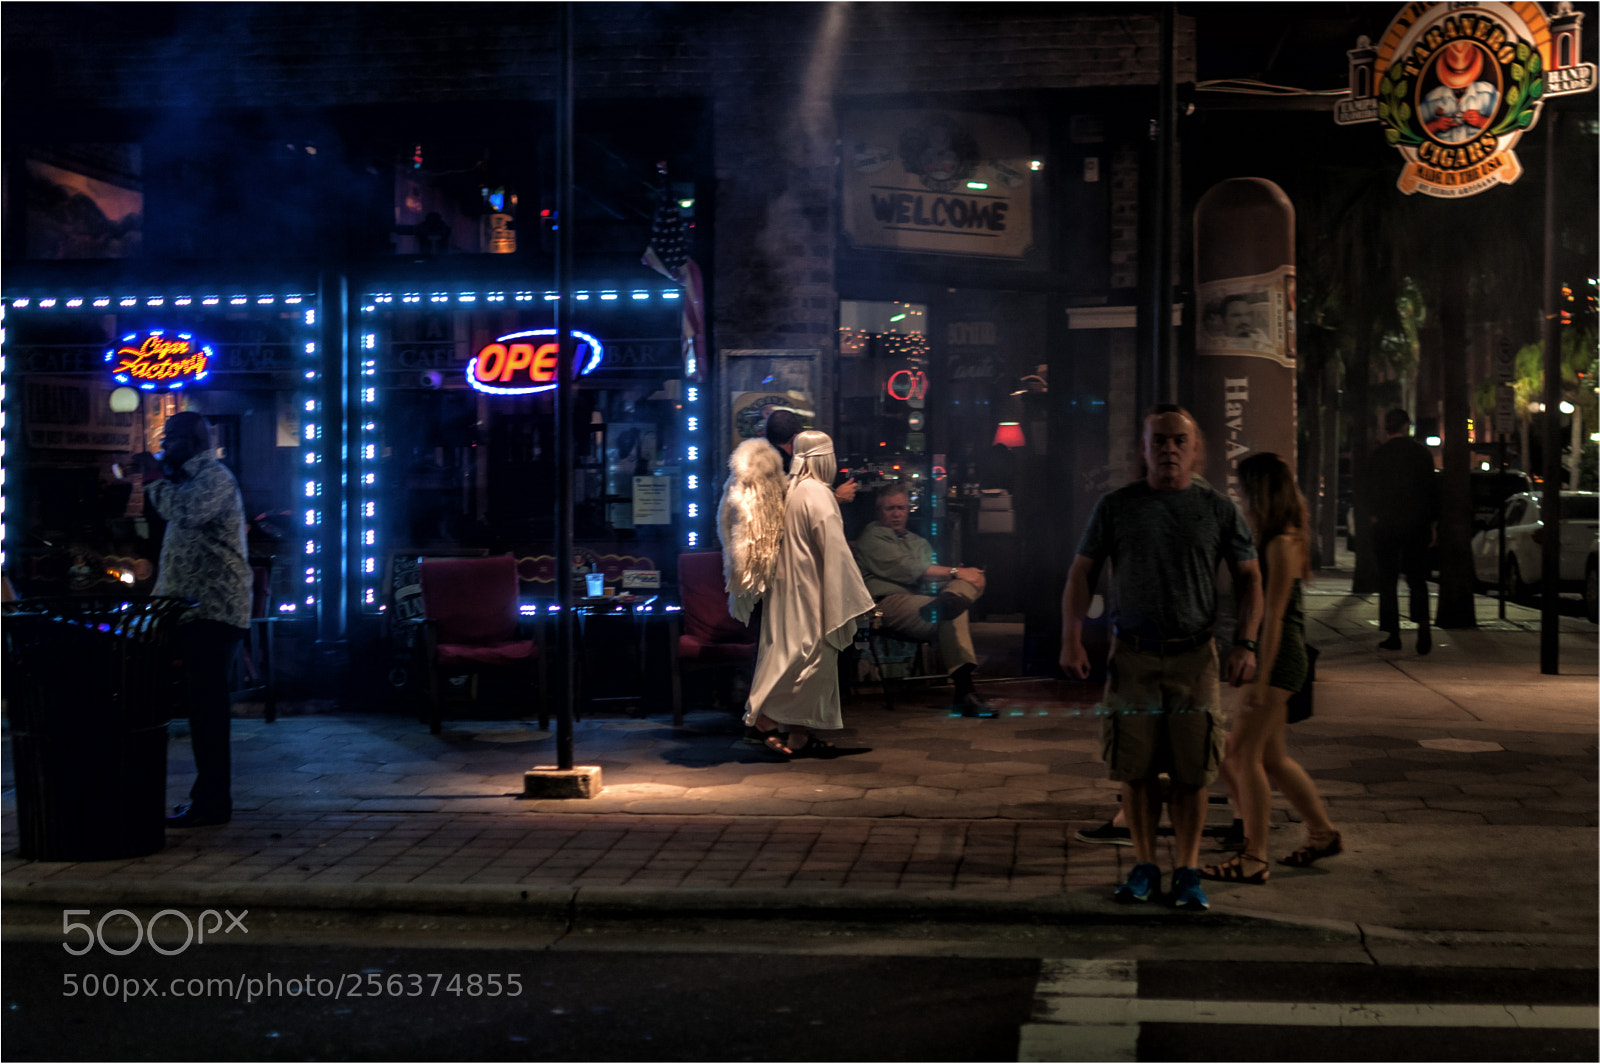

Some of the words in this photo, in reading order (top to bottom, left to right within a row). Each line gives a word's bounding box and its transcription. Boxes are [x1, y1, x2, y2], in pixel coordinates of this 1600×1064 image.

[1402, 14, 1516, 77] TABANERO
[1547, 66, 1591, 84] HAND
[1547, 78, 1590, 93] MADE
[1417, 134, 1500, 168] CIGARS
[1416, 165, 1443, 185] MADE
[1444, 169, 1457, 186] IN
[1459, 167, 1481, 184] THE
[1481, 156, 1503, 176] USA
[870, 194, 1009, 231] WELCOME
[140, 335, 190, 360] Cigar
[606, 345, 657, 364] BAR
[29, 351, 86, 371] CAFE
[230, 349, 275, 374] BAR
[112, 346, 207, 380] Factory
